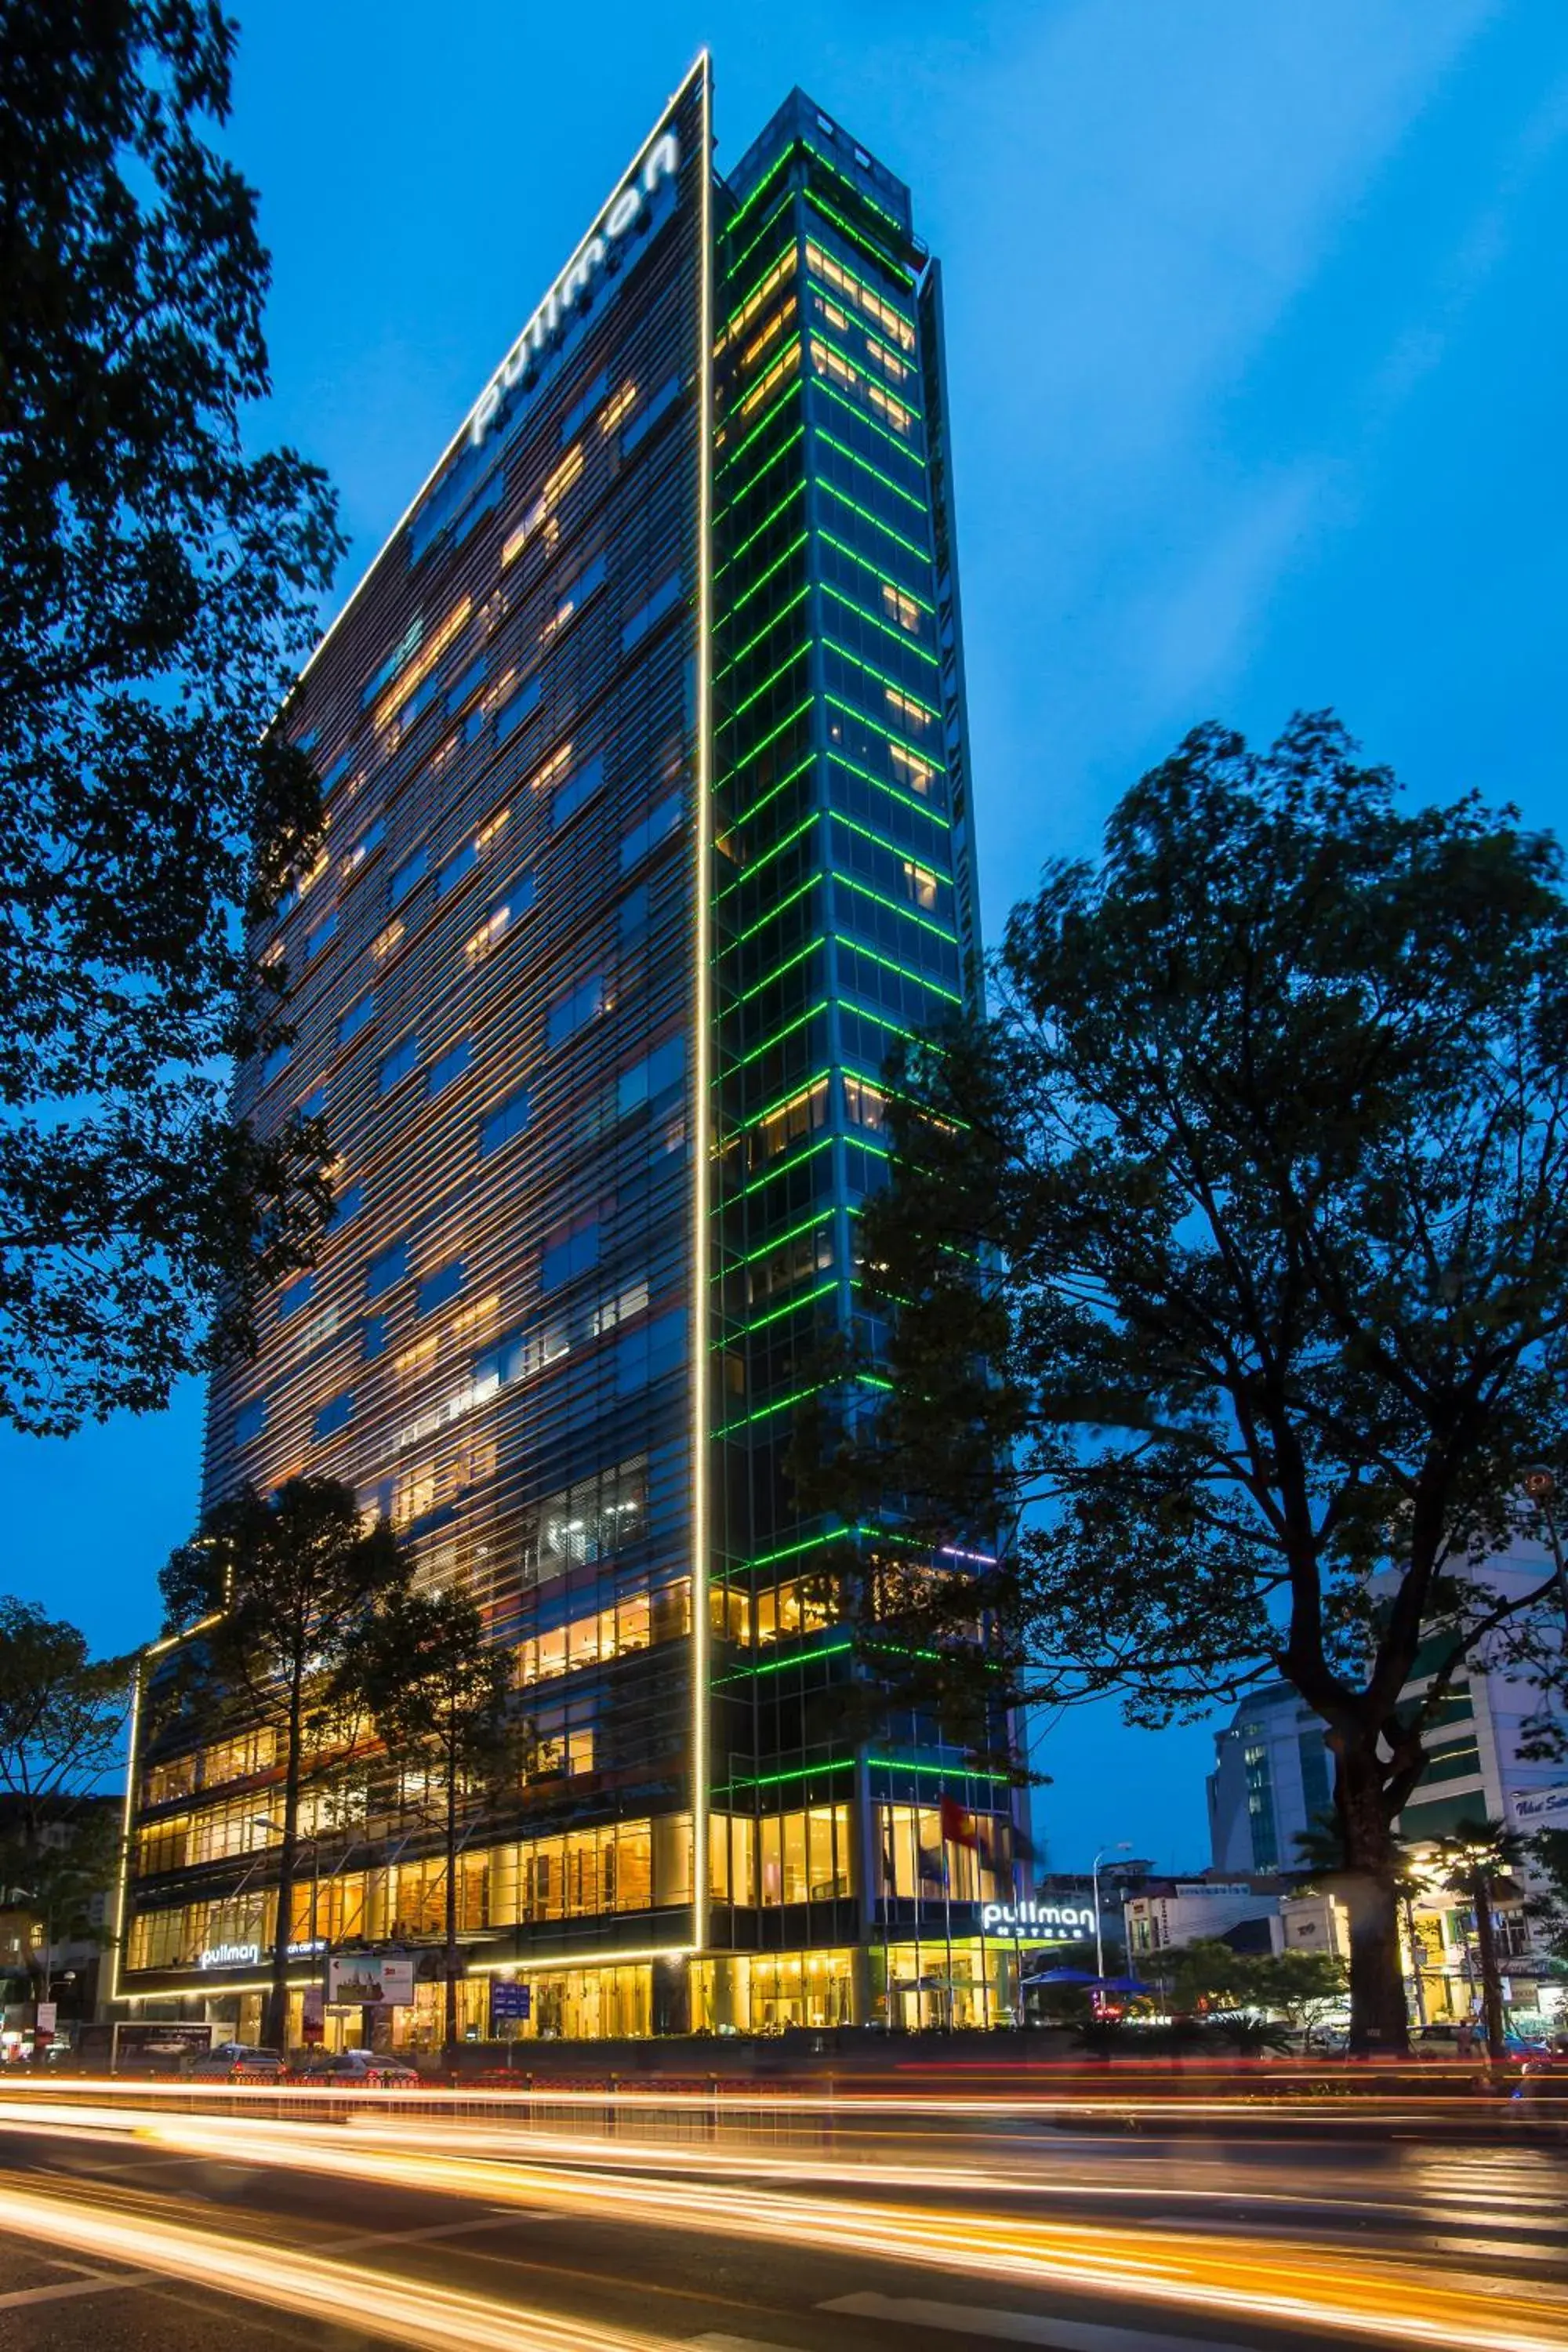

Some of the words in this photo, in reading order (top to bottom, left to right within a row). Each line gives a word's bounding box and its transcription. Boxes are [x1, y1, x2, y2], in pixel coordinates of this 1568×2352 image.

[472, 133, 677, 445] pullman
[984, 1901, 1094, 1933] pullman
[997, 1926, 1082, 1938] HOTELS
[201, 1944, 258, 1969] pullman
